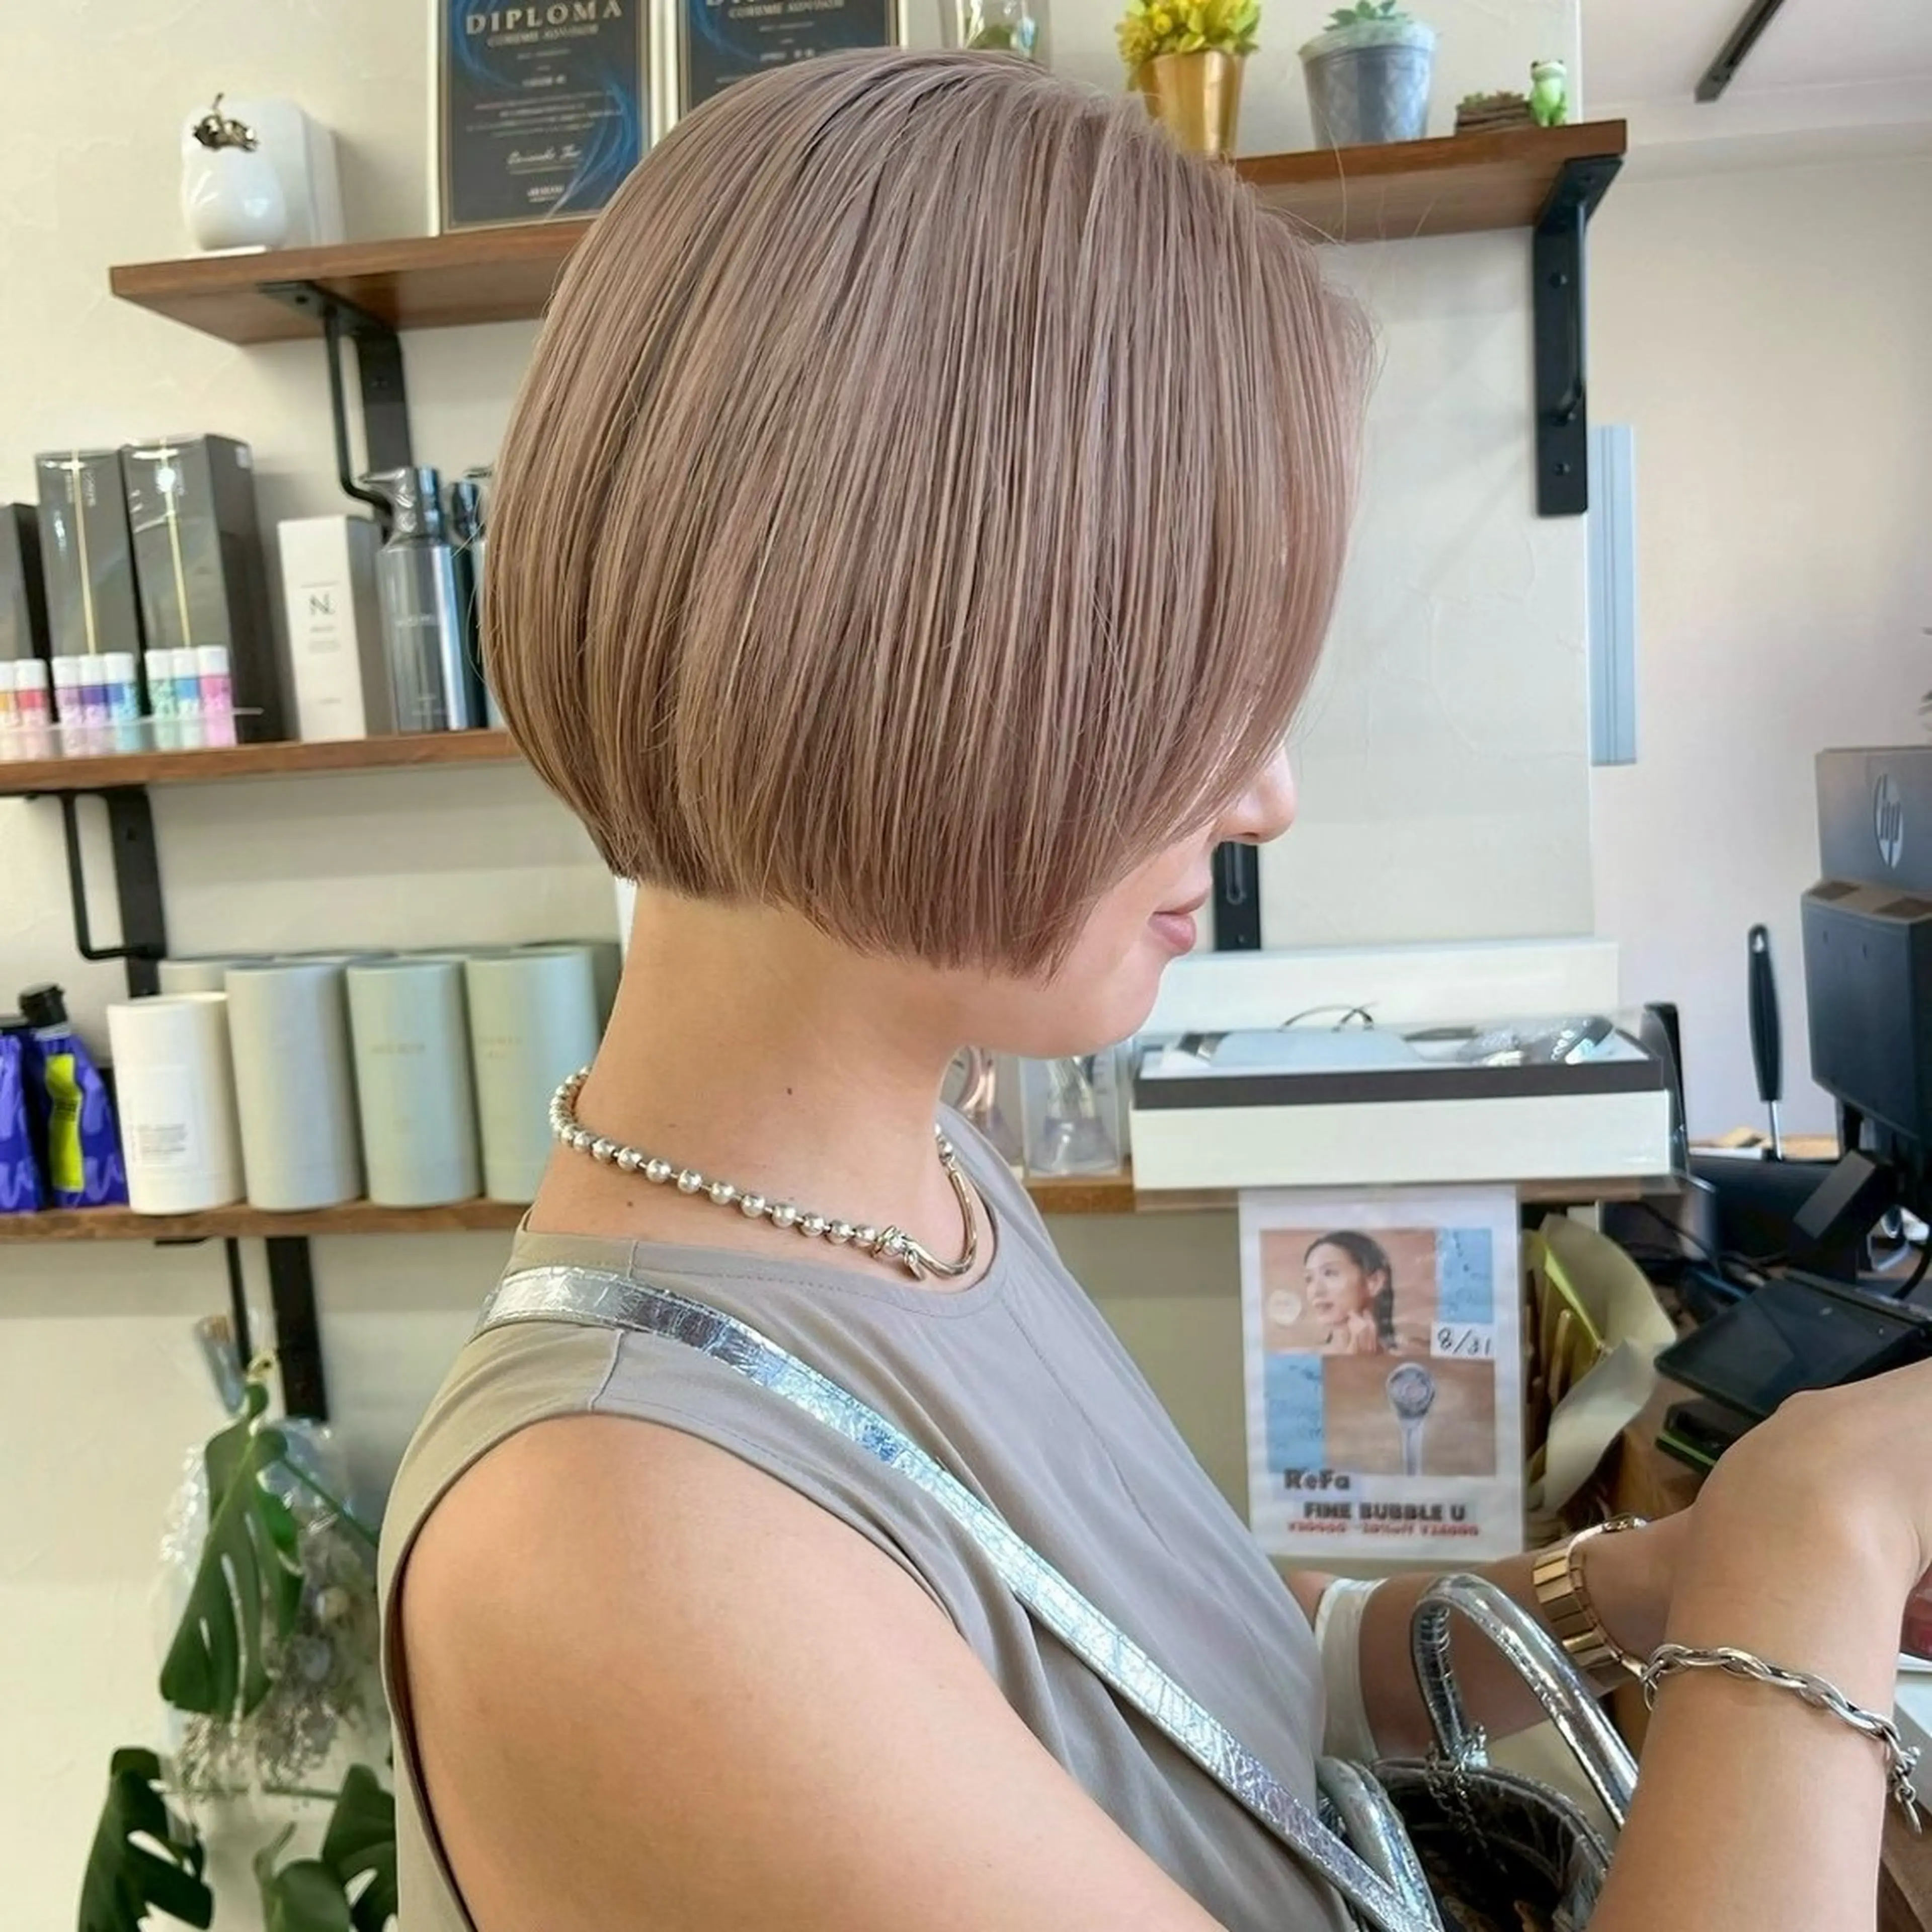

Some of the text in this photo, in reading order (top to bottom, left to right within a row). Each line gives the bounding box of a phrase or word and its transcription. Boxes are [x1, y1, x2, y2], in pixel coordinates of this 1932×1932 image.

[466, 0, 622, 35] DIPLOMA
[1437, 1327, 1491, 1355] 8/31
[1284, 1468, 1350, 1490] ReFa
[1304, 1501, 1466, 1521] FINE BUBBLE U
